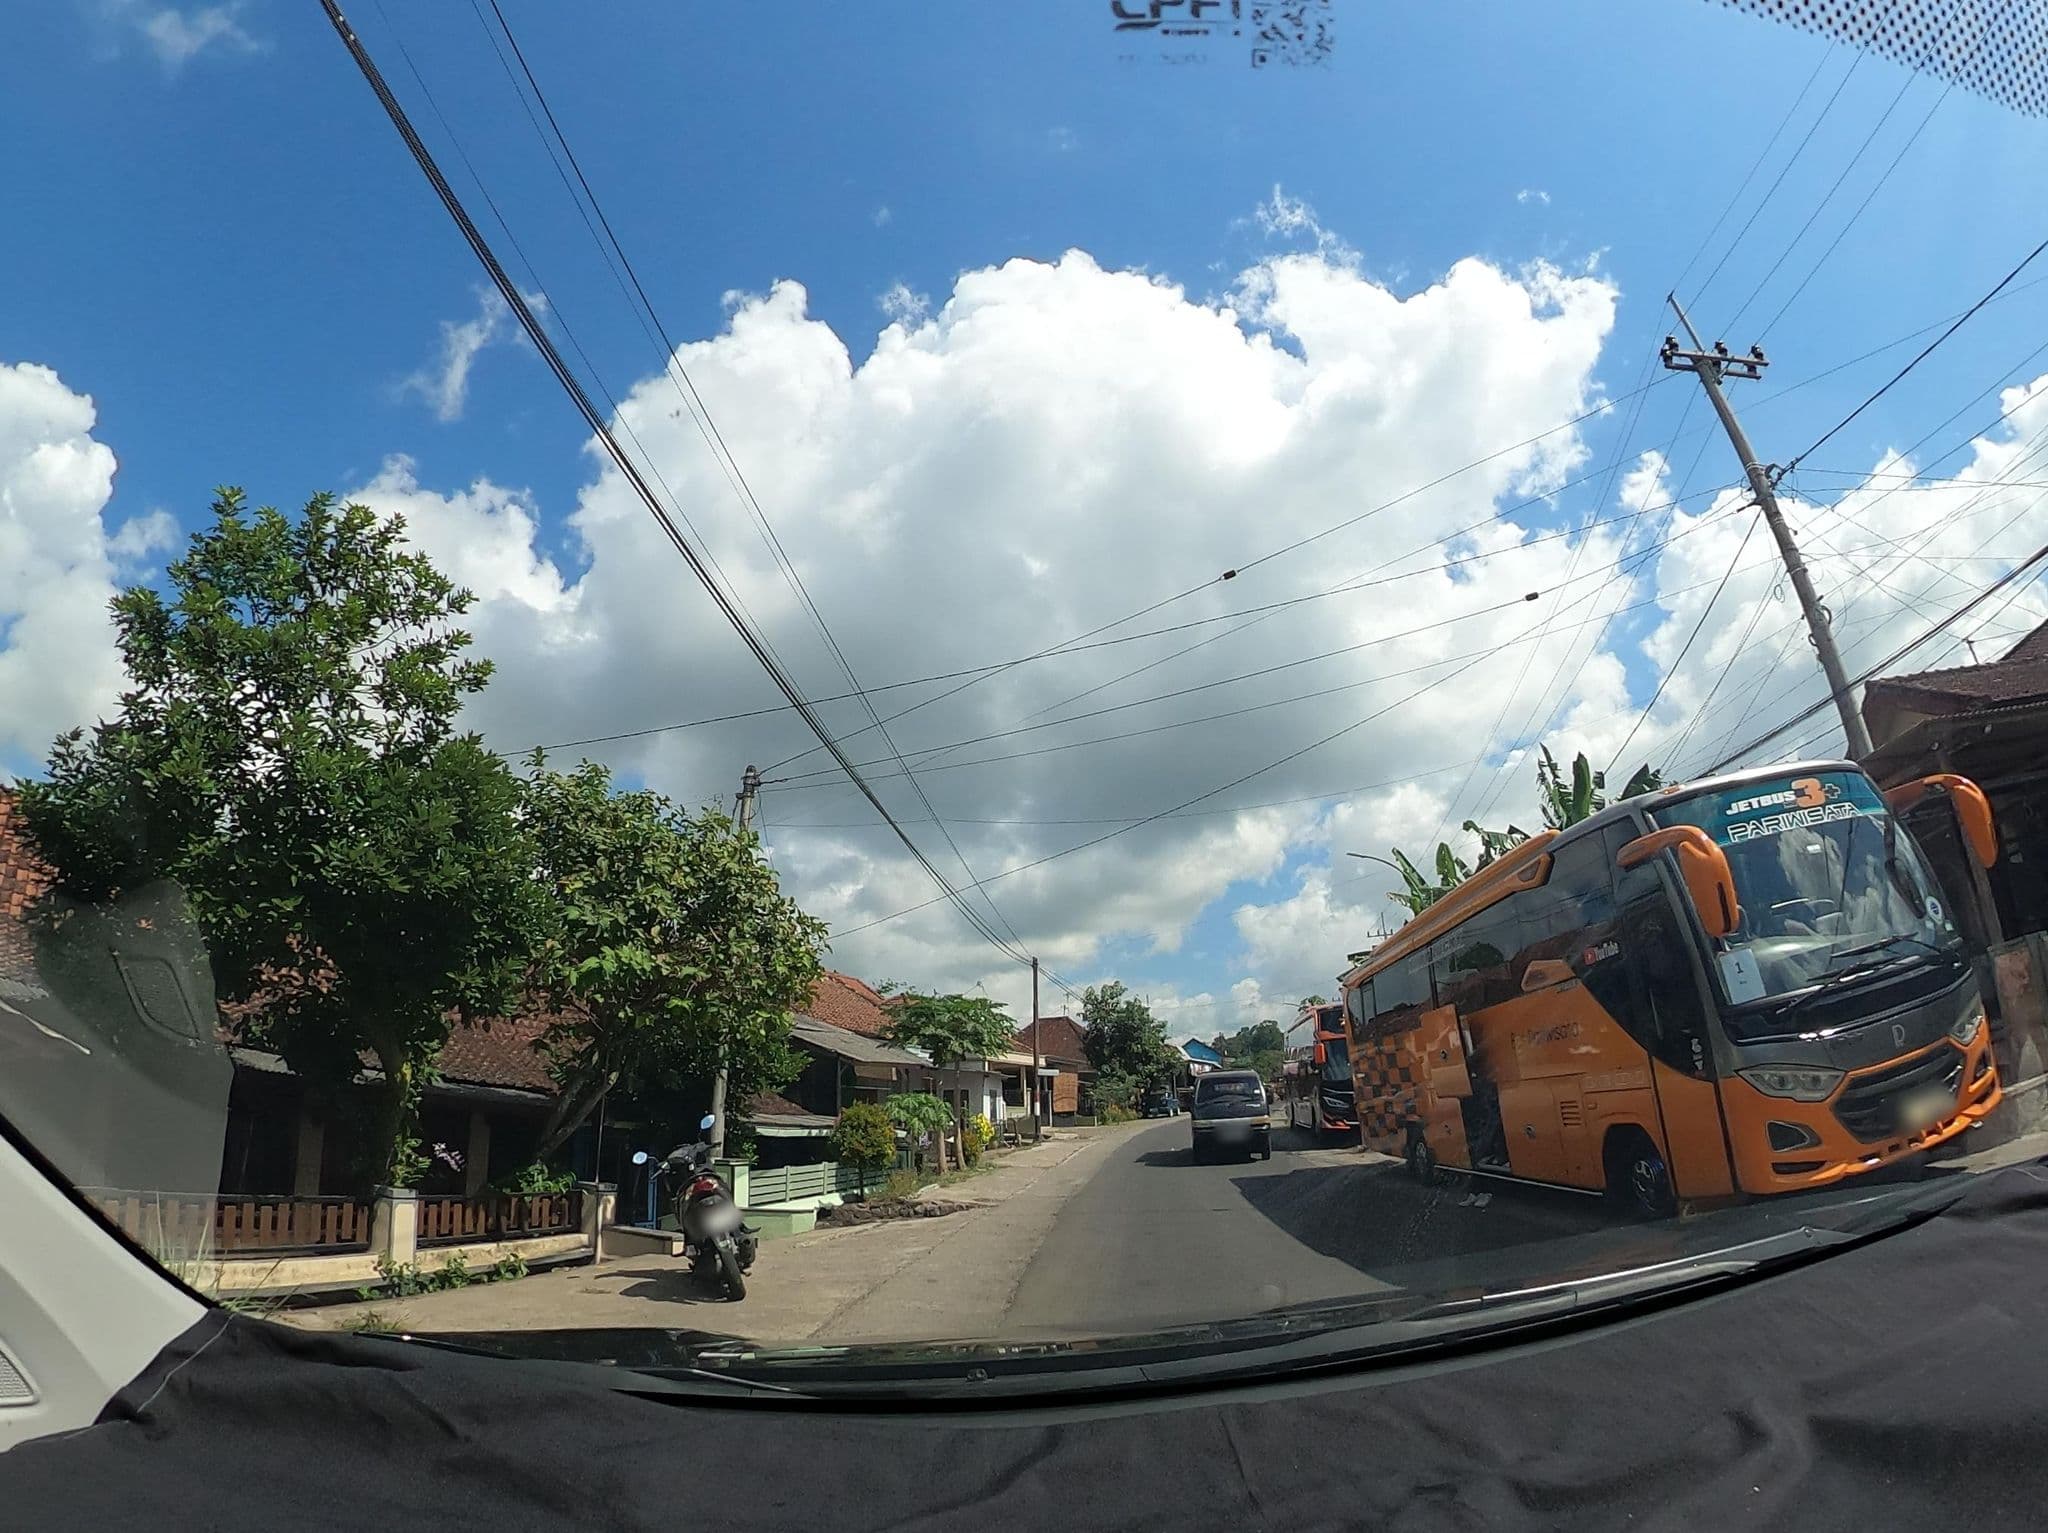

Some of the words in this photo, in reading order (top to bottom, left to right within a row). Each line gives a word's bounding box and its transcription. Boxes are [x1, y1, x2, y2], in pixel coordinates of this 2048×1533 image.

[1725, 790, 1798, 816] JETBUS
[1727, 801, 1863, 843] PARIWISATA
[1734, 961, 1745, 974] 1
